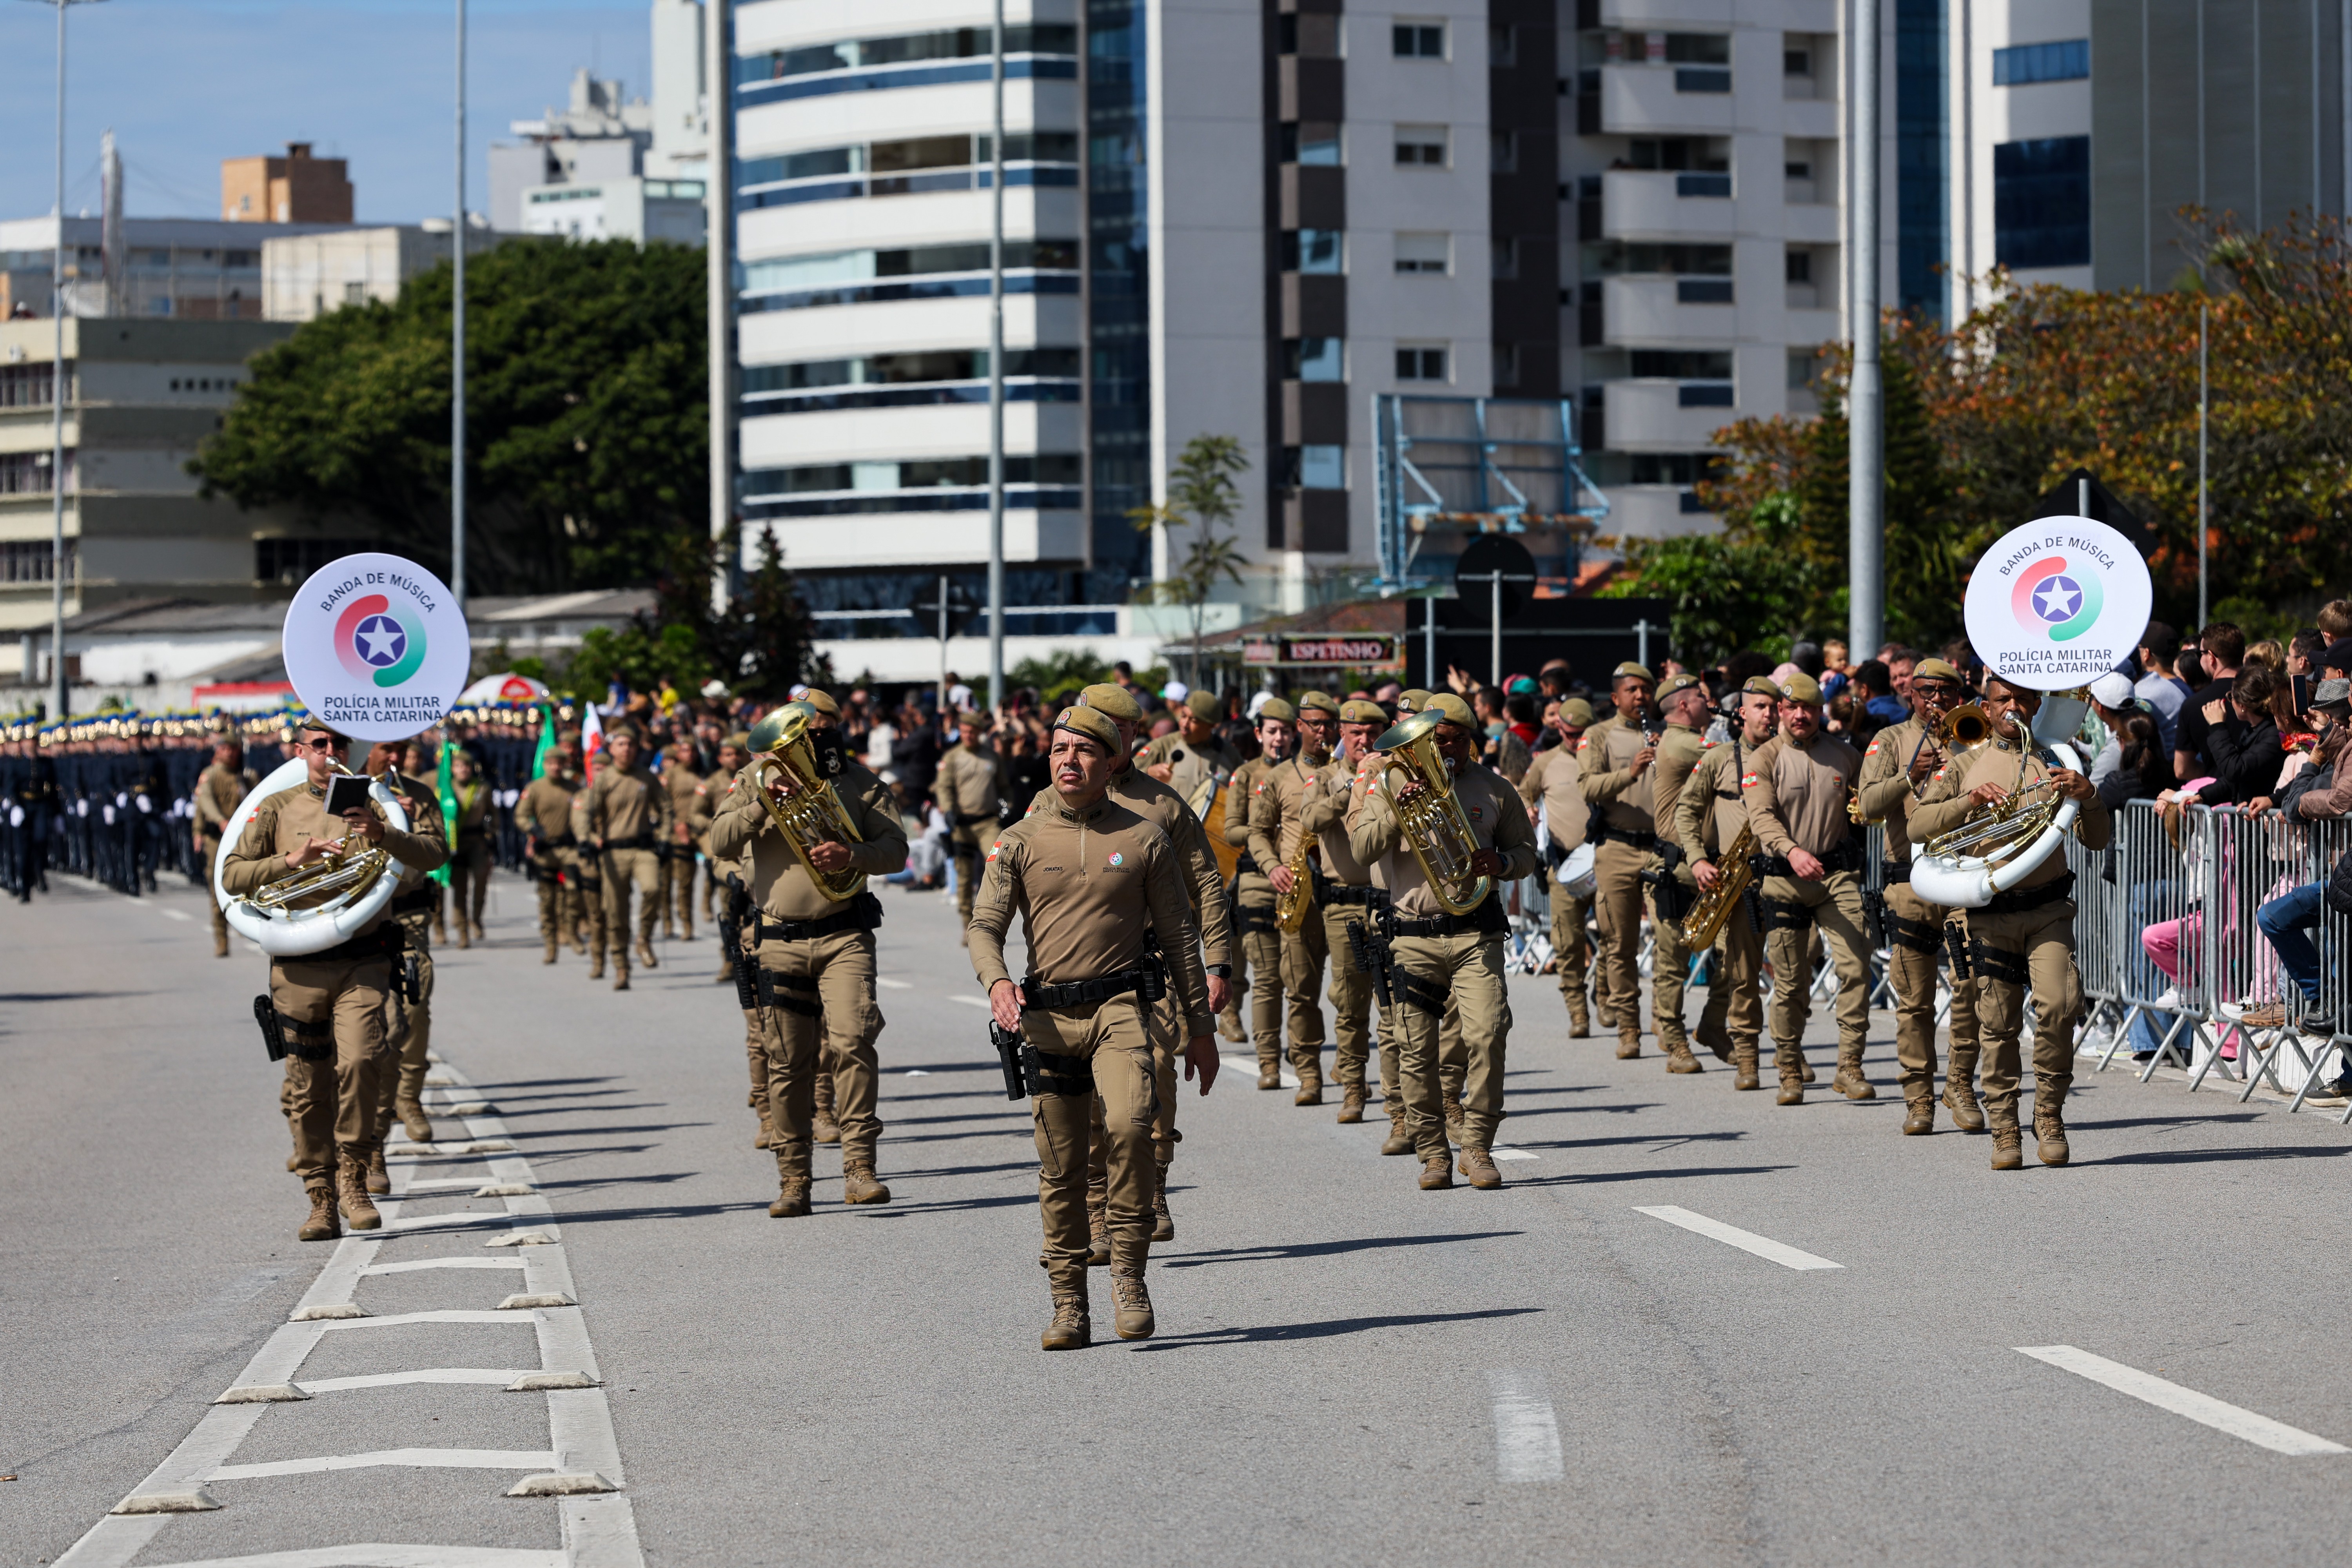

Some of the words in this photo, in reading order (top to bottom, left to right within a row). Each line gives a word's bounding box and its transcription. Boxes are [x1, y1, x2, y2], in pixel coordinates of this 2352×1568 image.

[2000, 542, 2041, 575] BANDA
[2045, 537, 2063, 548] DE
[2068, 537, 2114, 570] MÚSICA
[321, 577, 363, 612] BANDA
[367, 573, 385, 584] DE
[390, 574, 436, 613] MÚSICA
[2000, 648, 2053, 662] POLÍCIA
[2058, 649, 2112, 660] MILITAR
[1999, 664, 2042, 675] SANTA
[2047, 662, 2112, 674] CATARINA
[325, 694, 380, 708] POLÍCIA
[385, 697, 440, 708] MILITAR
[323, 710, 370, 722] SANTA
[374, 710, 443, 722] CATARINA
